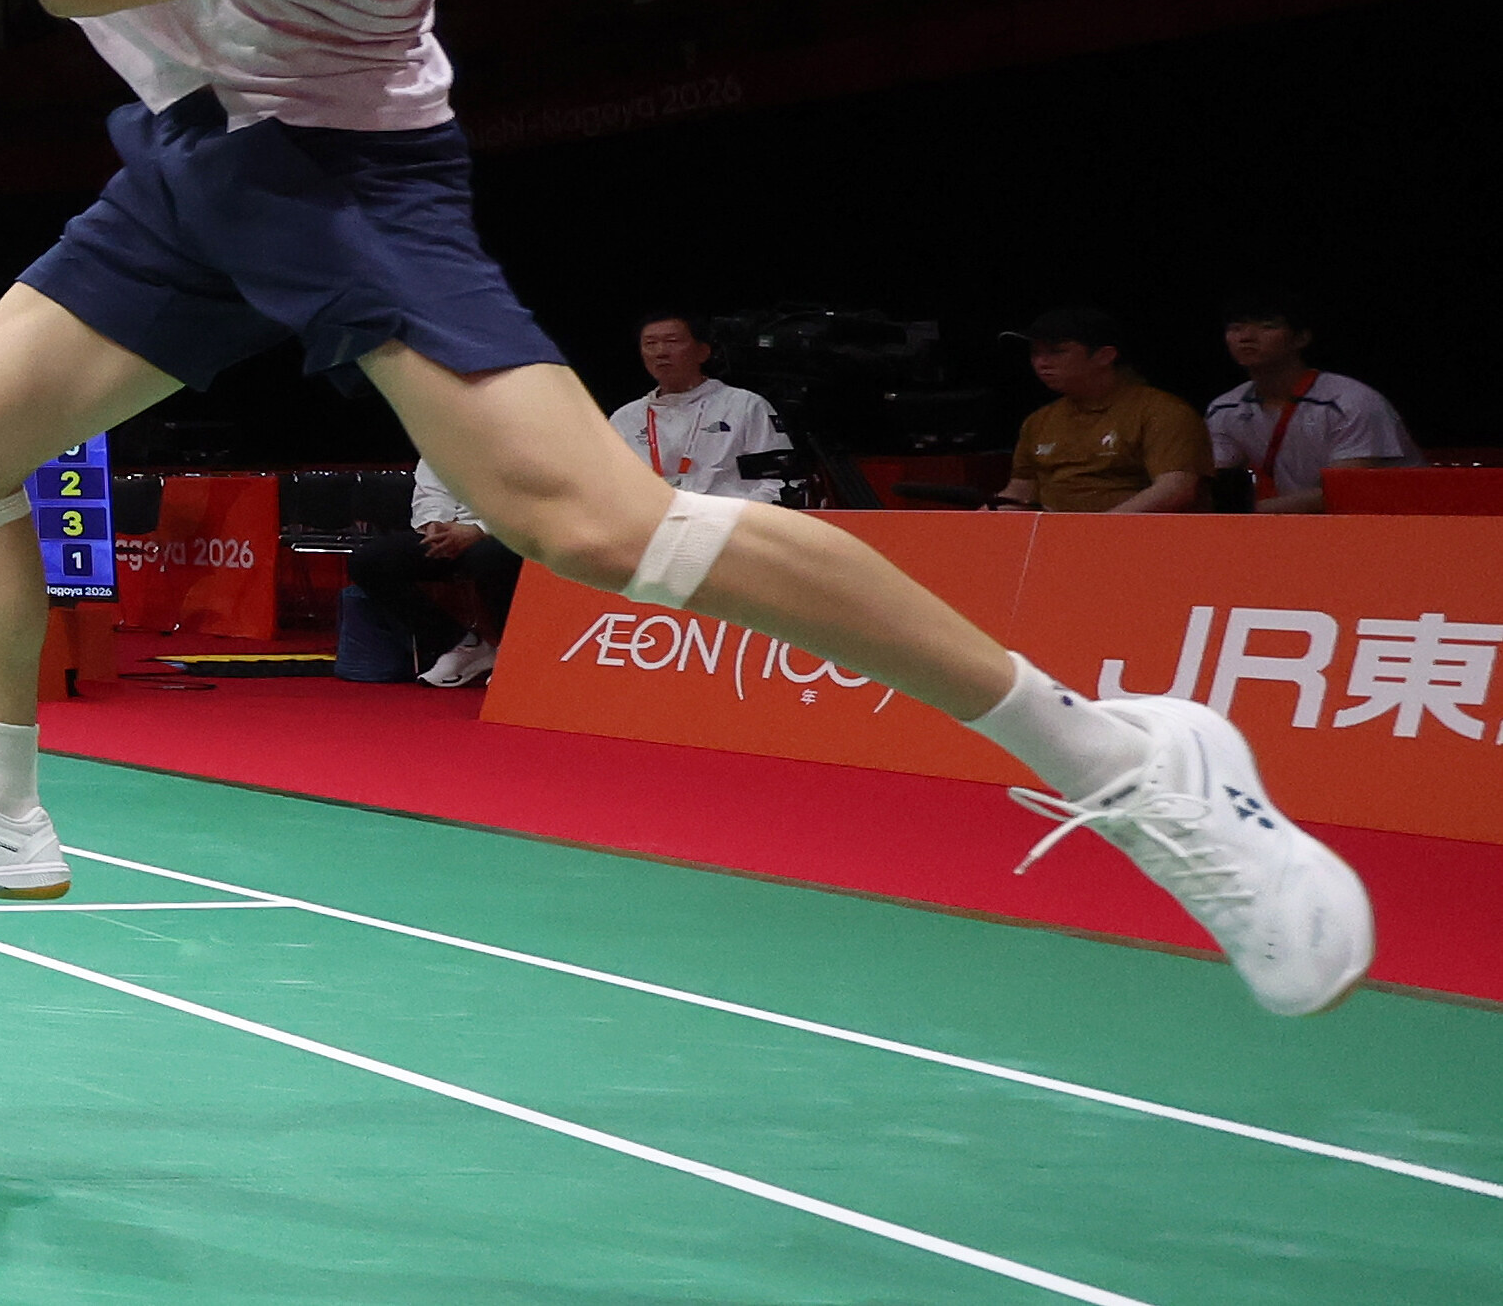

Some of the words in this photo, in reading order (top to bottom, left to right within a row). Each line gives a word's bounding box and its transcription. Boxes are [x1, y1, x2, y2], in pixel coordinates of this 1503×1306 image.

[60, 470, 82, 497] 2
[62, 510, 84, 537] 3
[72, 551, 83, 570] 1
[193, 537, 256, 570] 2026
[84, 586, 113, 597] 2026
